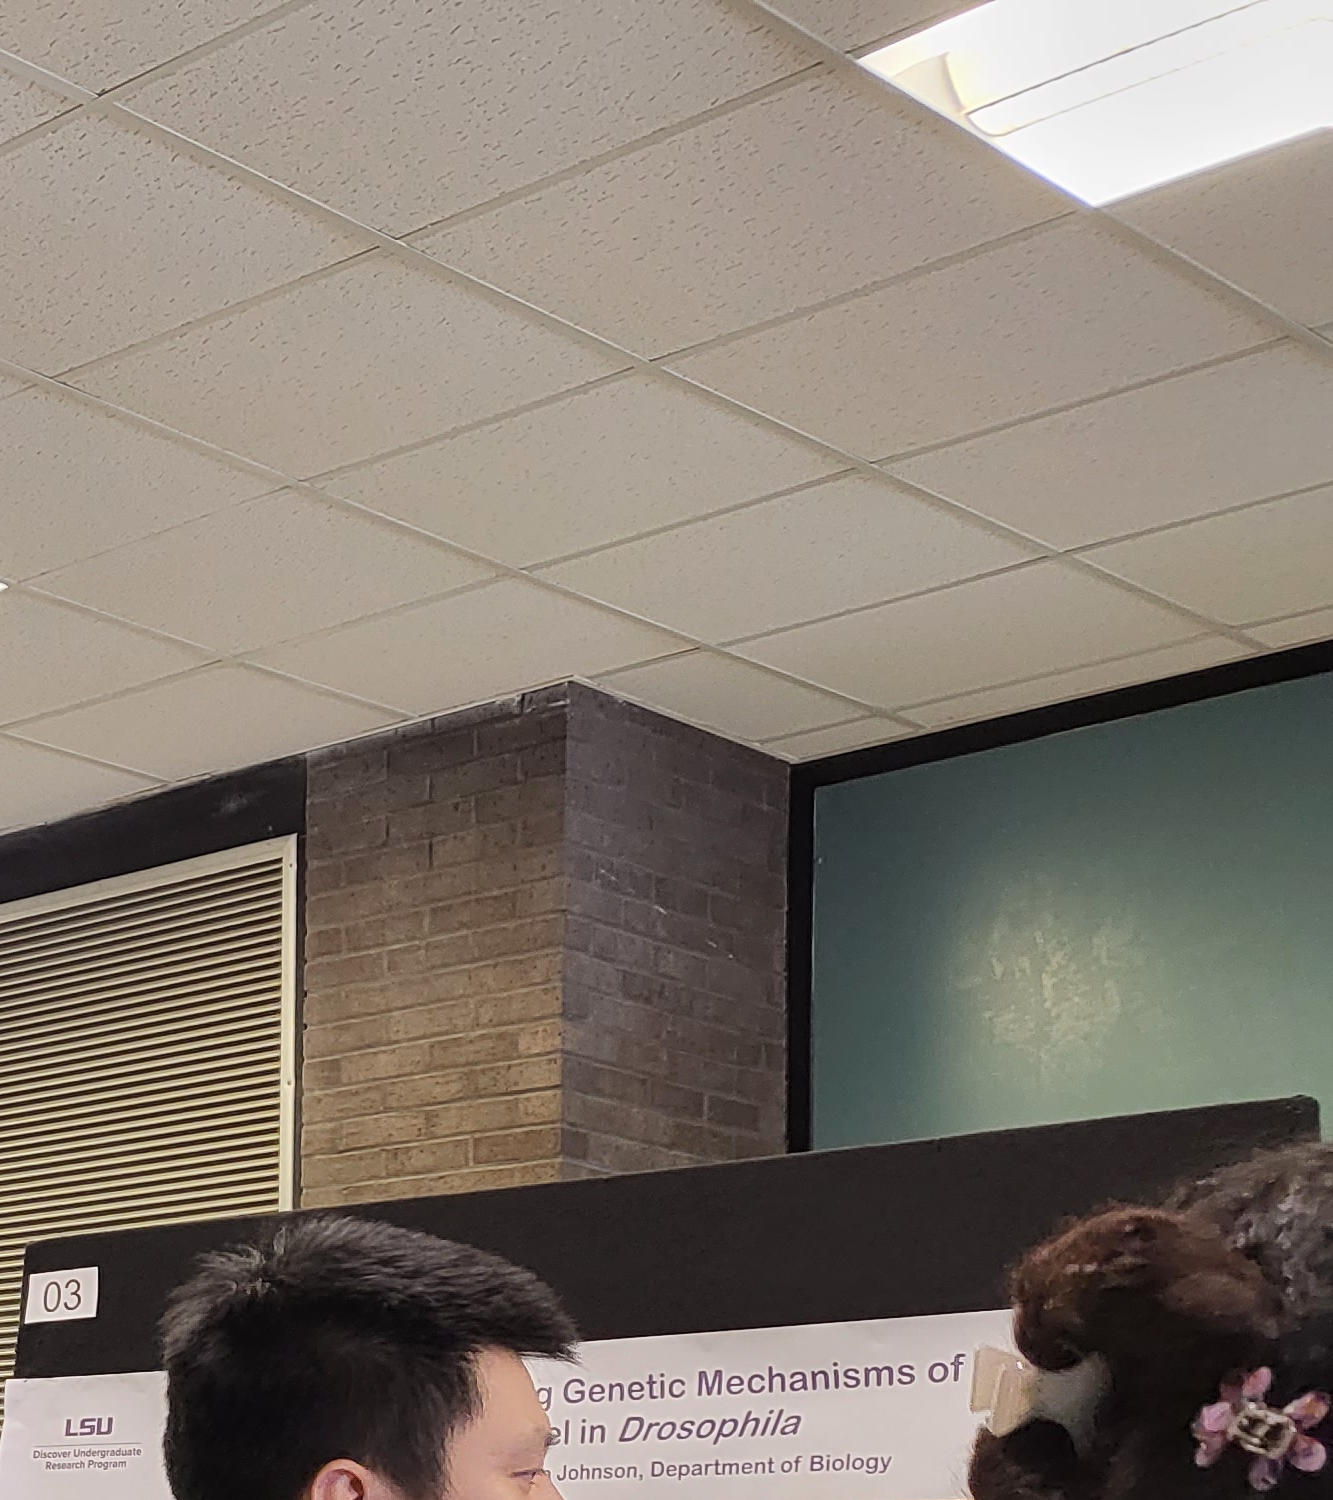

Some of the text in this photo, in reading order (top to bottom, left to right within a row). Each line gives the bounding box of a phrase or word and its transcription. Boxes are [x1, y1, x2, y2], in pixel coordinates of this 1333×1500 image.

[43, 1278, 82, 1312] 03
[563, 1374, 686, 1404] Genetic
[697, 1361, 915, 1397] Mechanisms
[928, 1354, 965, 1383] of
[65, 1417, 114, 1436] LSU
[580, 1418, 606, 1445] in
[618, 1409, 802, 1445] Drosophila
[33, 1447, 142, 1459] Discover Undergraduate
[45, 1459, 126, 1470] Research Program
[556, 1453, 892, 1482] Johnson, Department of Biology
